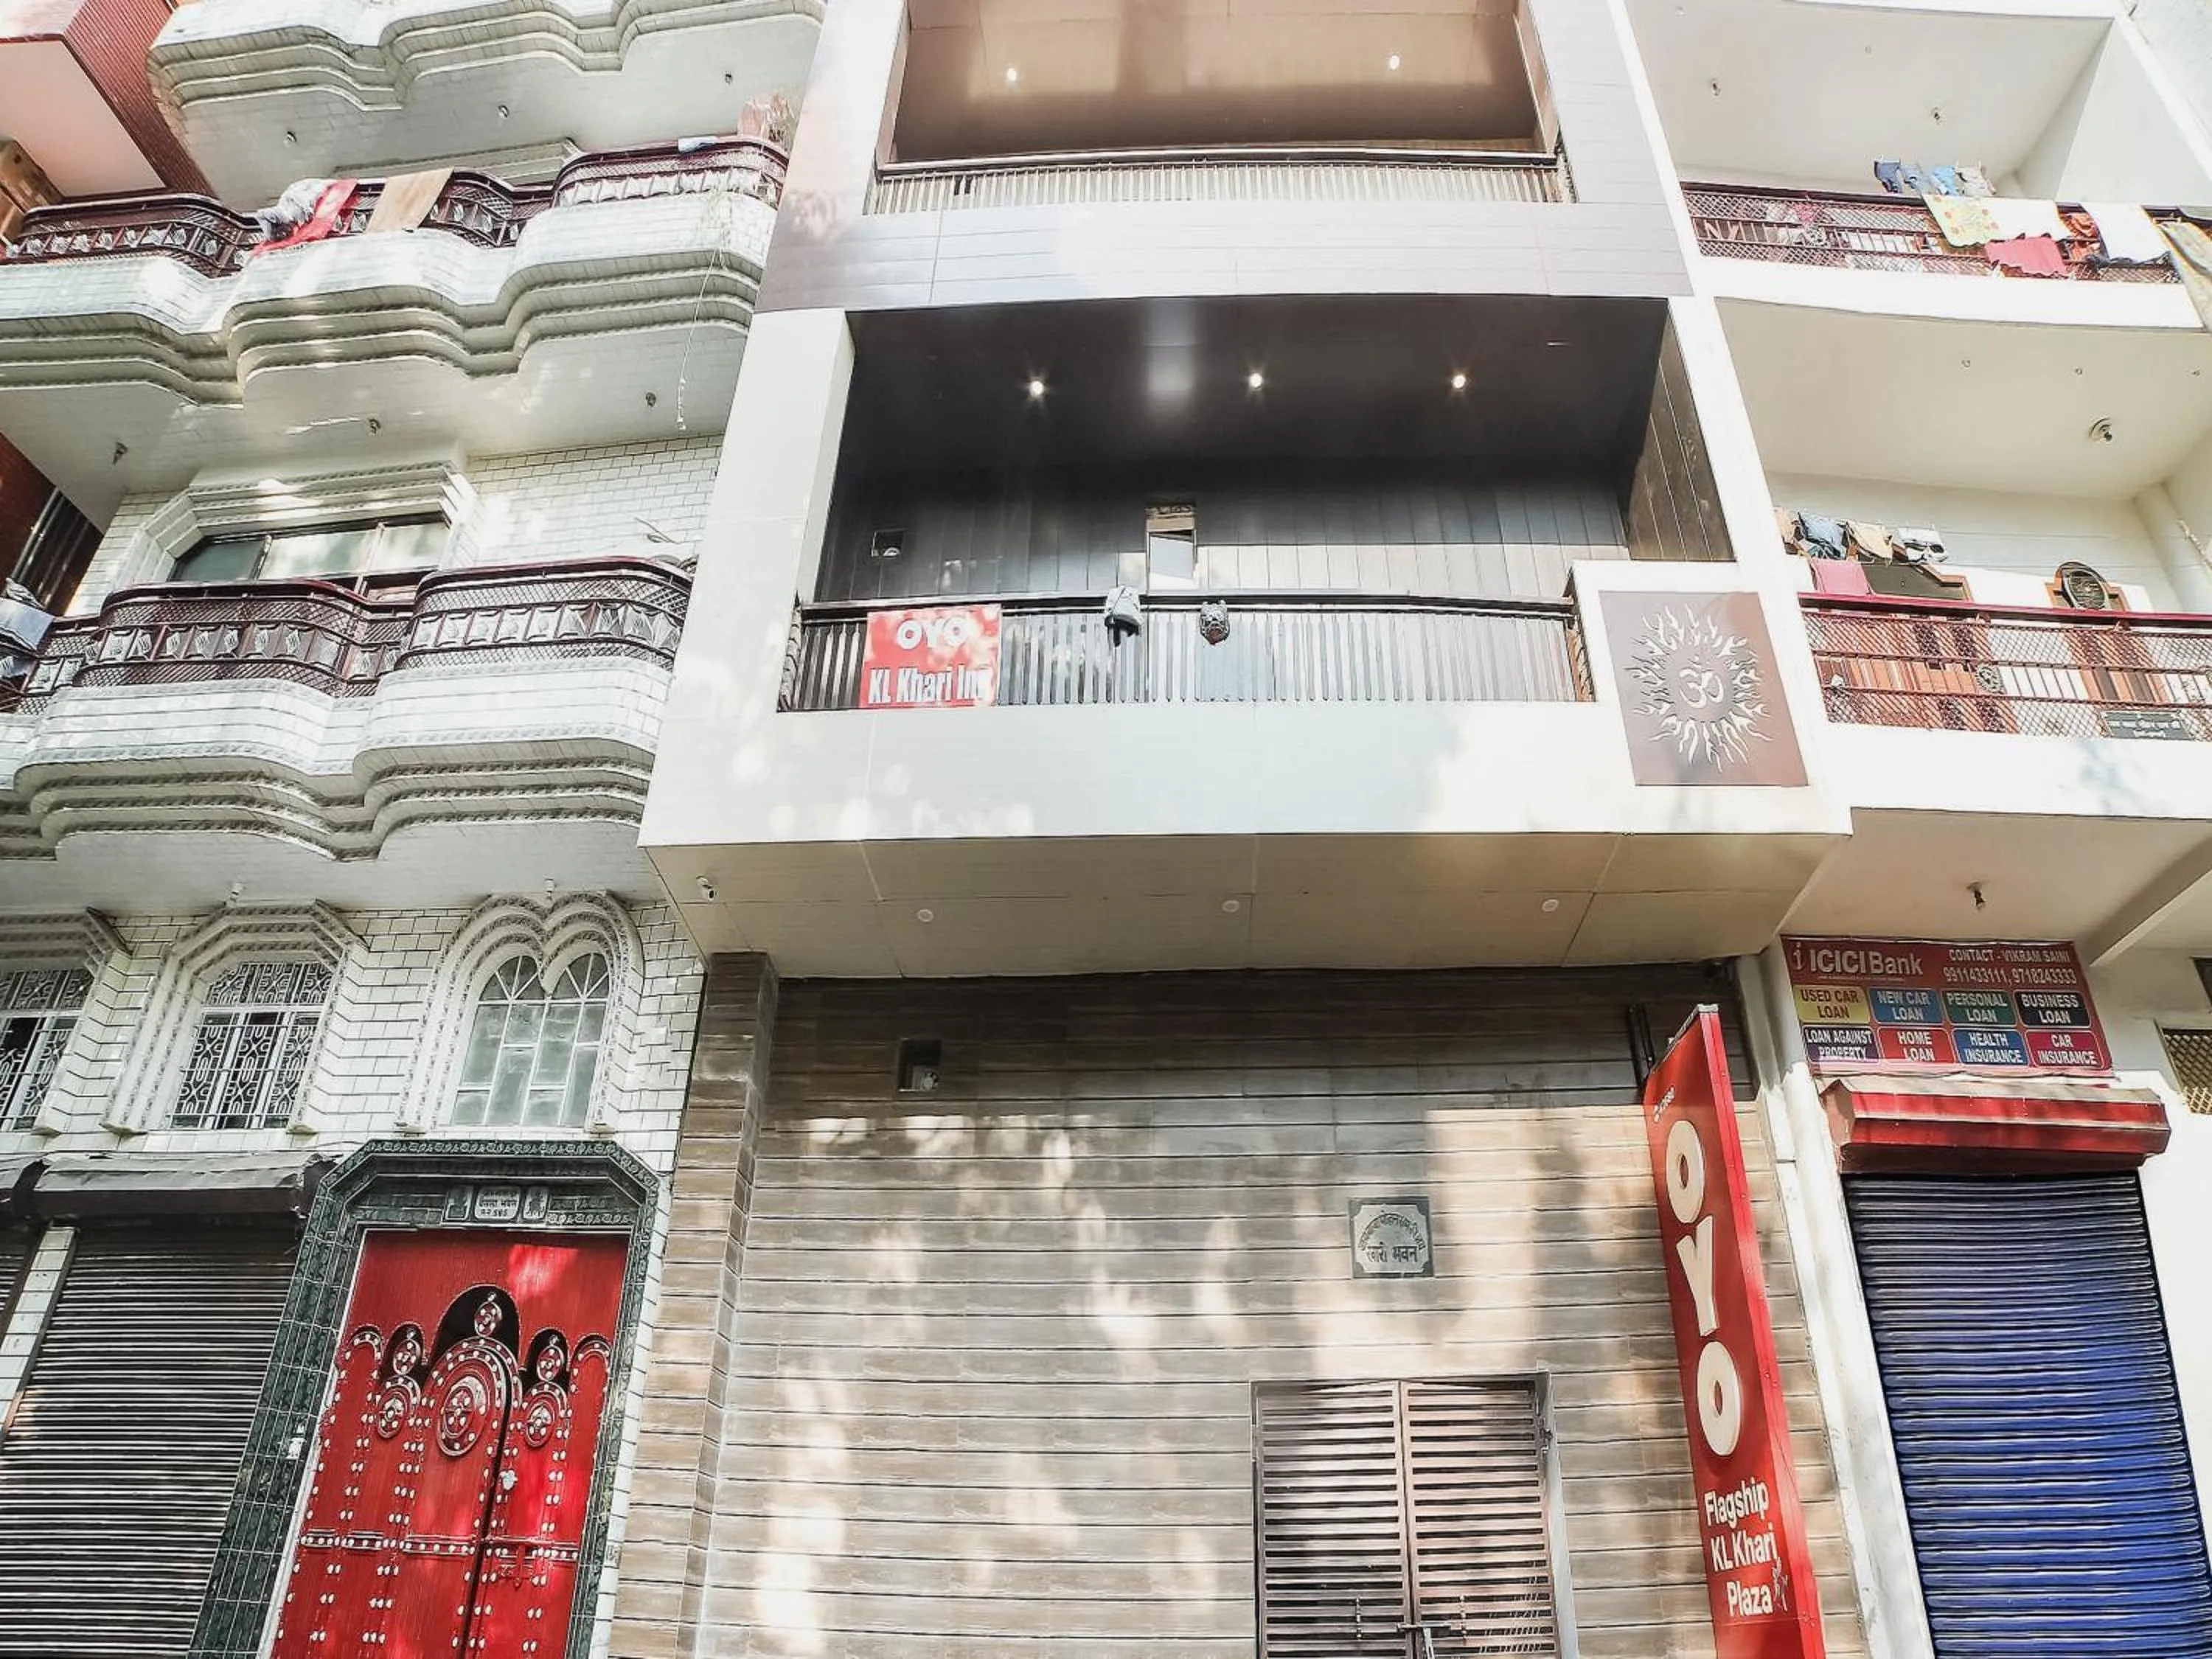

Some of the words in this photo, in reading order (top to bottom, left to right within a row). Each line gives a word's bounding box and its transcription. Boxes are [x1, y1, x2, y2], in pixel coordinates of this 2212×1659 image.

[897, 616, 968, 650] OYO
[869, 668, 891, 704] KL
[897, 667, 953, 703] Khari
[1810, 949, 1866, 973] ICICI
[1869, 951, 1923, 975] Bank
[1949, 949, 1993, 961] CONTACT
[2001, 950, 2042, 962] VIKRAM
[1800, 989, 1832, 1002] USED
[1834, 990, 1860, 1004] CAR
[1877, 990, 1904, 1004] NEW
[1907, 992, 1930, 1006] CAR
[1946, 992, 2008, 1007] PERSONAL
[2021, 994, 2079, 1009] BUSINESS
[1817, 1005, 1850, 1019] LOAN
[1891, 1007, 1924, 1020] LOAN
[1966, 1009, 1997, 1023] LOAN
[2038, 1010, 2071, 1024] LOAN
[1806, 1030, 1831, 1044] LOAN
[1833, 1031, 1873, 1044] AGAINST
[1898, 1032, 1933, 1046] HOME
[1969, 1032, 2008, 1047] HEALTH
[2050, 1034, 2074, 1048] CAR
[1818, 1046, 1867, 1060] PROPERTY
[1903, 1047, 1935, 1062] LOAN
[1964, 1048, 2024, 1063] INSURANCE
[2037, 1049, 2097, 1065] INSURANCE
[1666, 1120, 1742, 1456] OYO
[1704, 1477, 1769, 1528] Flagship
[1711, 1535, 1733, 1571] KL
[1732, 1523, 1778, 1567] Khari
[1726, 1580, 1773, 1617] Plaza
